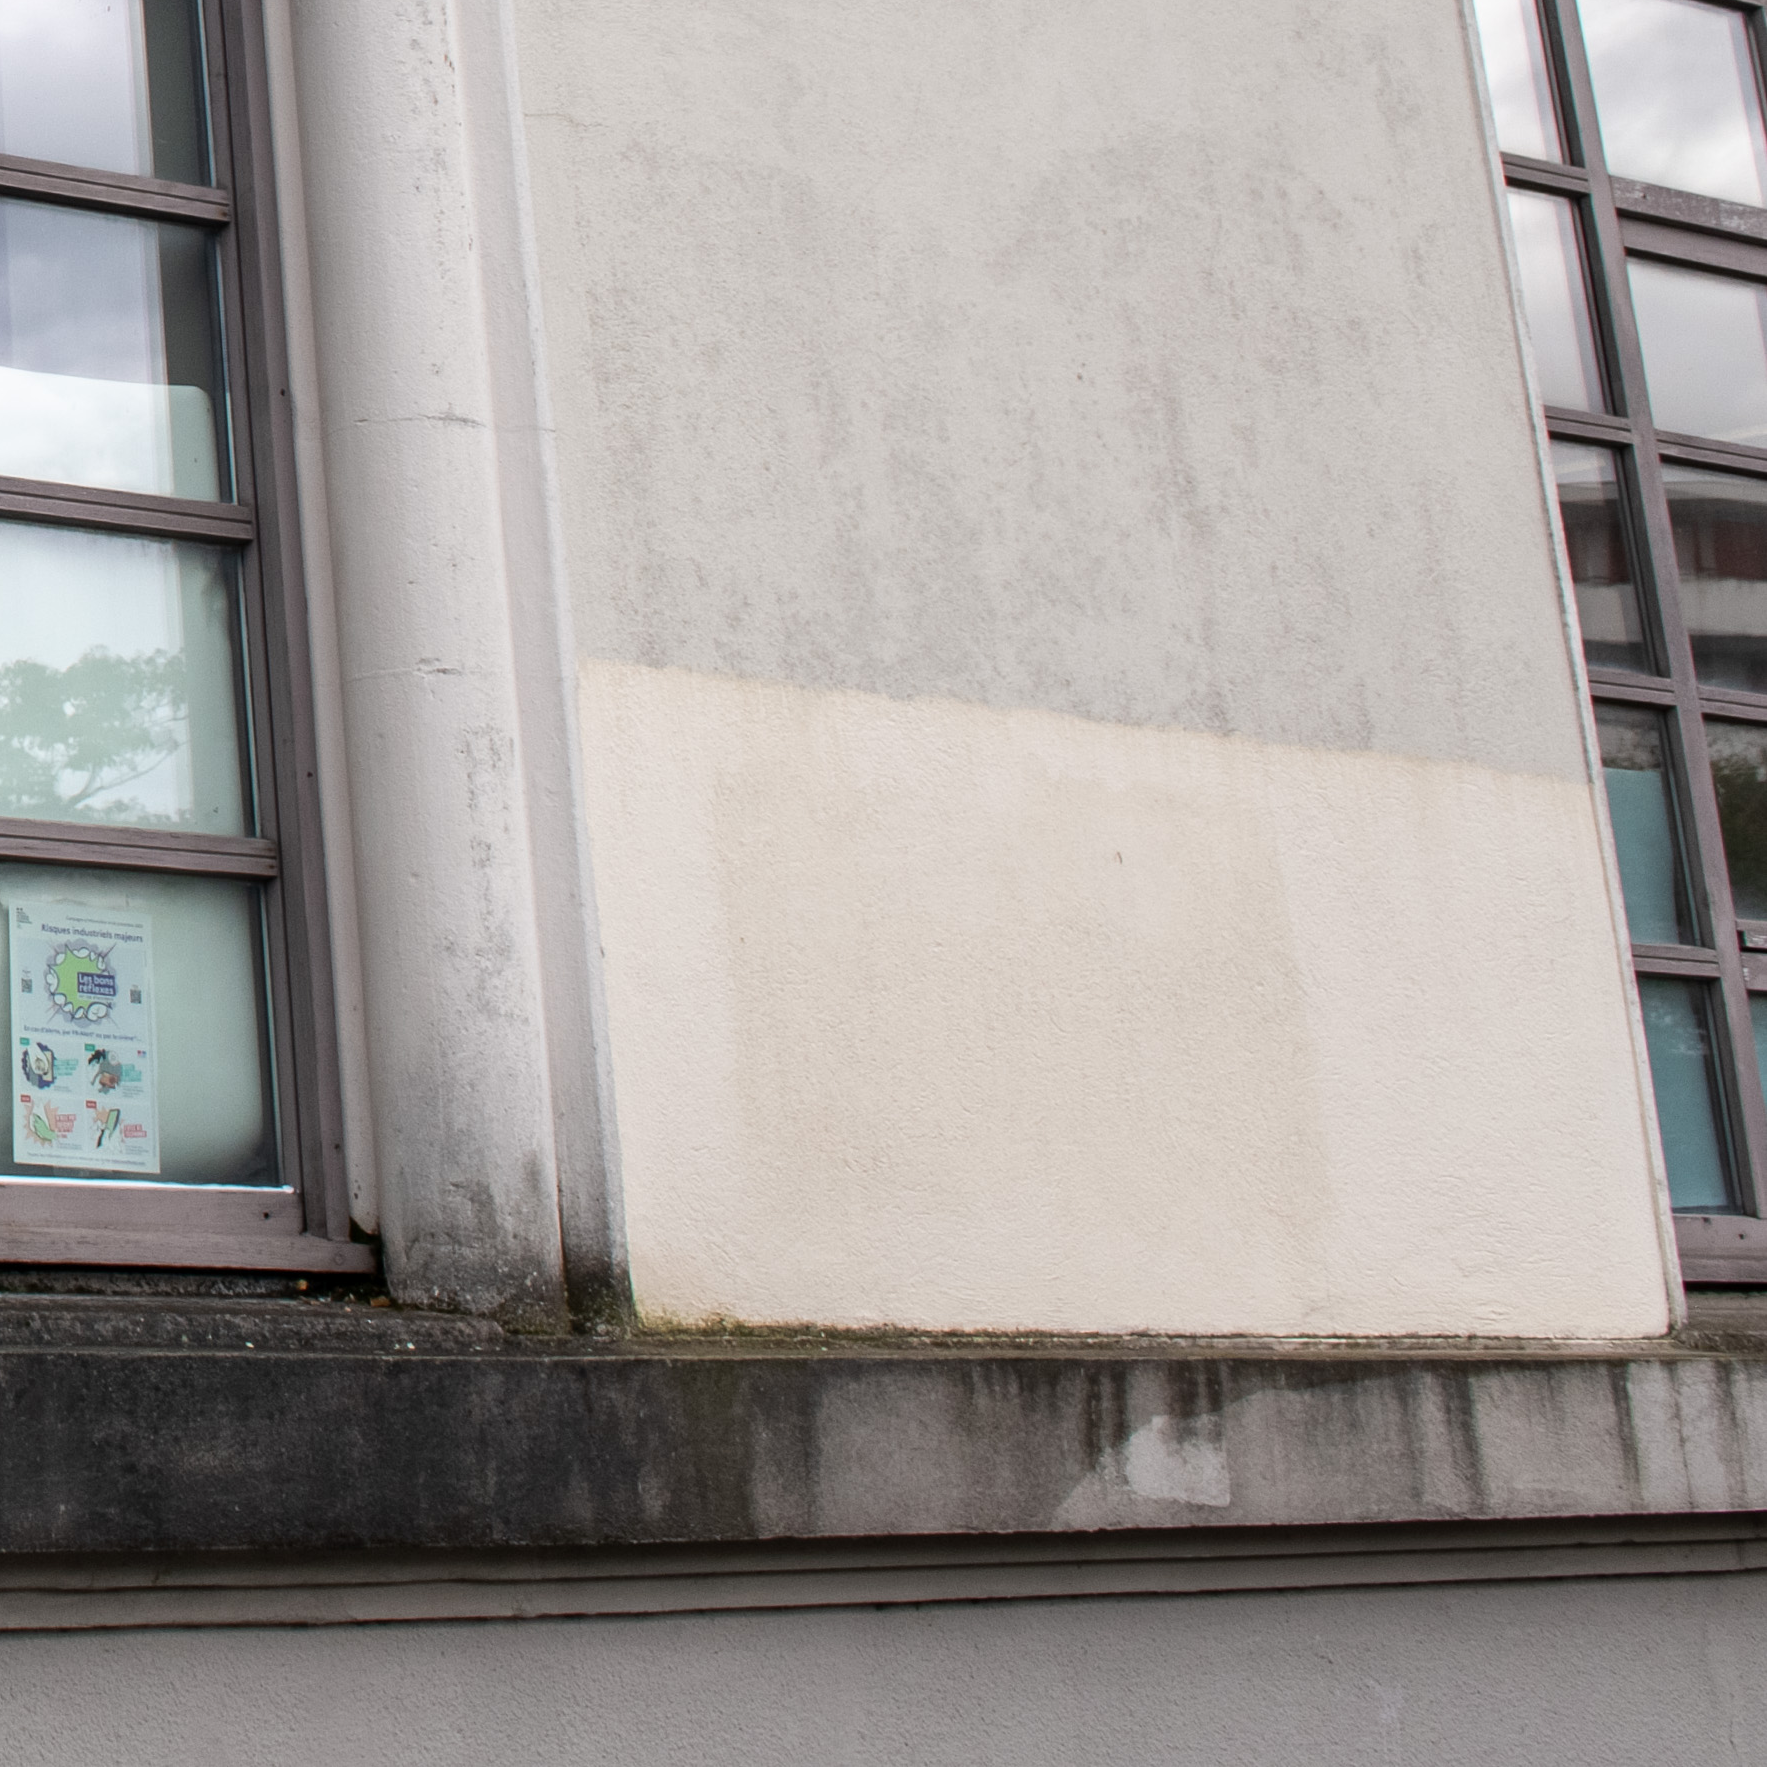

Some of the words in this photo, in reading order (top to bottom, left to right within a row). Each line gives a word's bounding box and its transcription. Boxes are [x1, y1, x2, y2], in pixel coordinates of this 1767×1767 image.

[41, 923, 71, 935] Risques
[72, 925, 112, 939] industriels
[114, 931, 143, 943] majeurs
[78, 973, 92, 983] Les
[93, 975, 114, 986] bons
